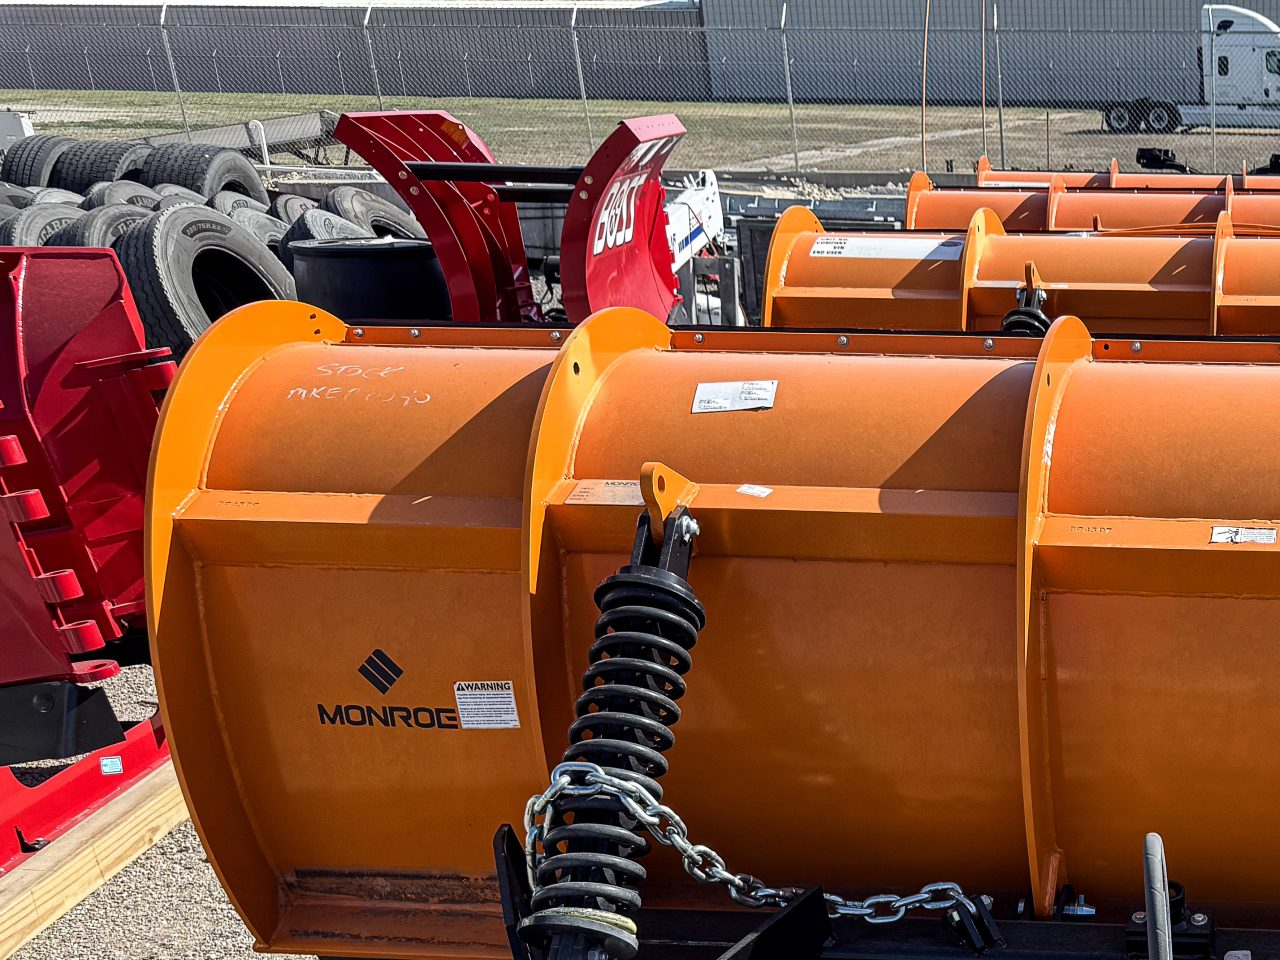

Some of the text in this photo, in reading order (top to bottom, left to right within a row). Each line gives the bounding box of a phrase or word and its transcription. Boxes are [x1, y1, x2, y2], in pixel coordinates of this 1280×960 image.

[593, 173, 648, 256] BOSS
[464, 682, 511, 691] WARNING
[317, 703, 459, 729] MONROE
